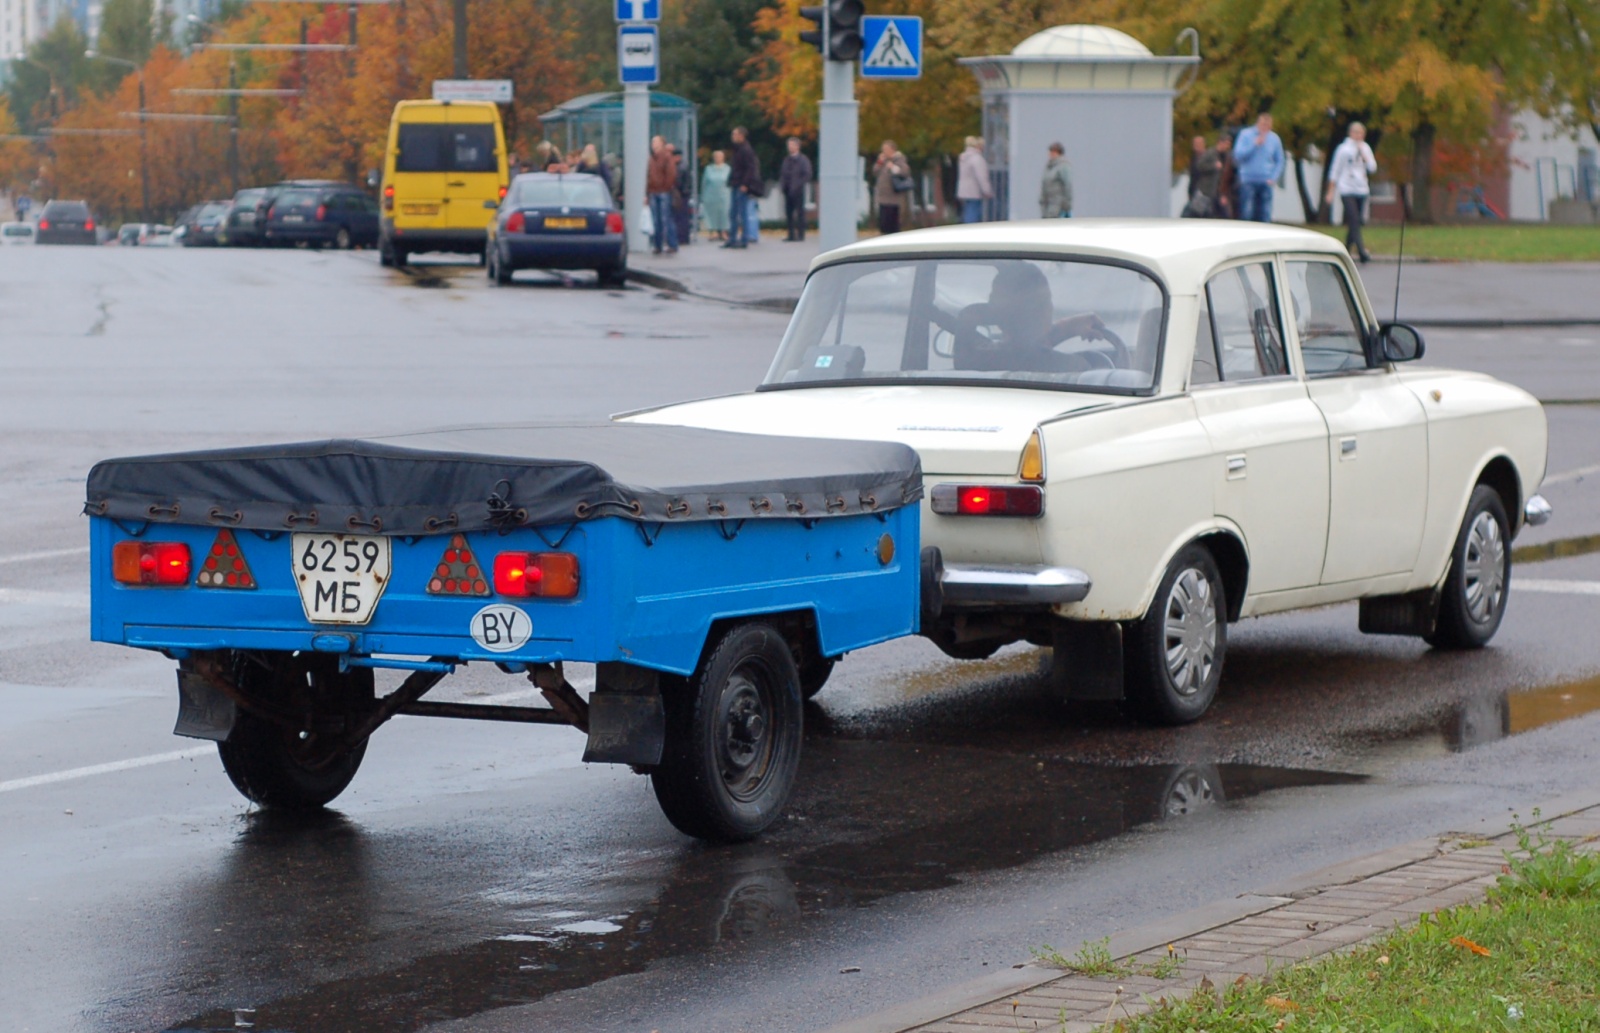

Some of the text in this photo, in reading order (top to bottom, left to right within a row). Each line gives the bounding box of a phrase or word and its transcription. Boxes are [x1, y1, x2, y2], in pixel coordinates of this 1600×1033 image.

[302, 539, 379, 573] 6259
[314, 580, 361, 613] МБ
[482, 611, 516, 644] BY
